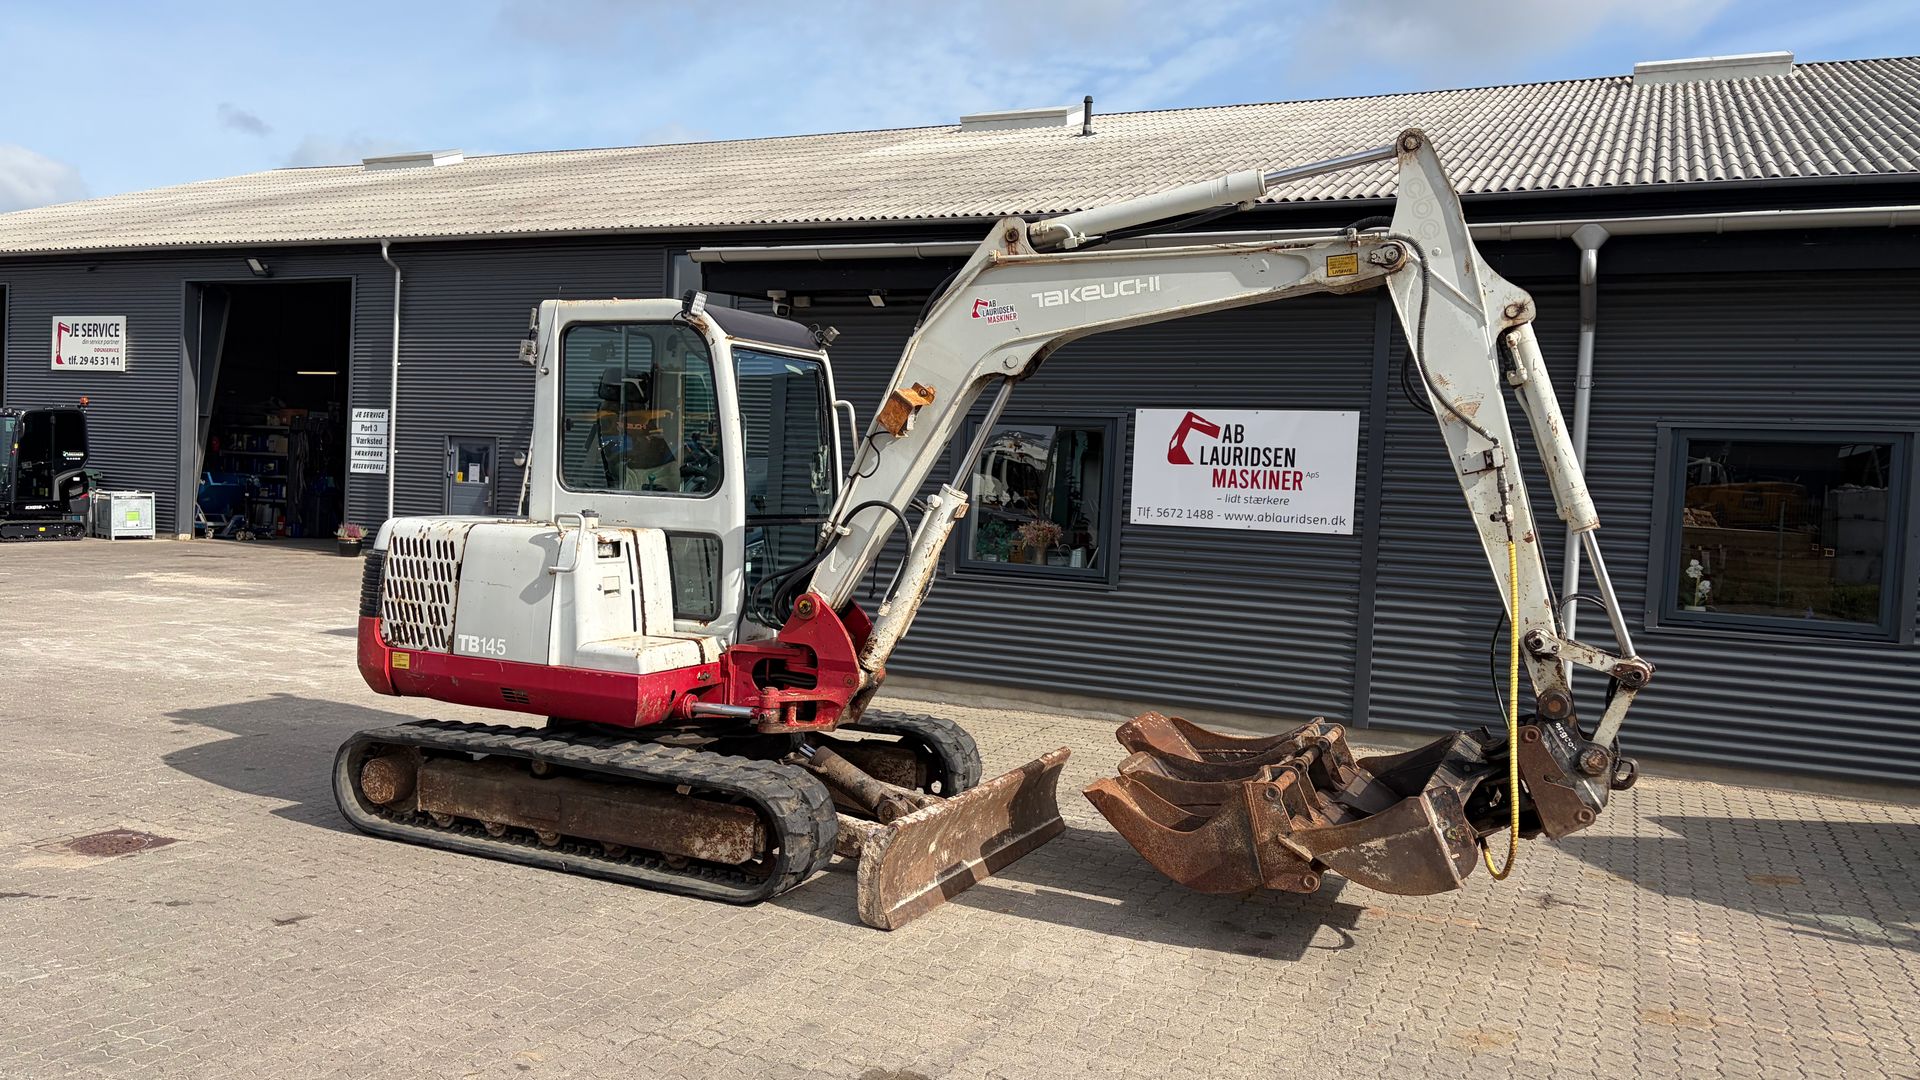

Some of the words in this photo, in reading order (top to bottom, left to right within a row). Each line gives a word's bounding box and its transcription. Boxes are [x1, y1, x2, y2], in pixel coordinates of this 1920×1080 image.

[1032, 274, 1161, 308] TAKEUCHI
[987, 313, 1017, 324] MASKINER
[69, 323, 79, 338] JE
[82, 323, 120, 338] SERVICE
[68, 355, 78, 365] tlf.
[80, 356, 89, 365] 29
[90, 356, 99, 365] 45
[100, 356, 109, 366] 31
[111, 356, 120, 366] 41
[363, 411, 385, 419] SERVICE
[361, 424, 373, 432] Port
[374, 424, 378, 432] 3
[1222, 424, 1244, 444] AB
[356, 437, 383, 445] Værksted
[1200, 446, 1296, 468] LAURIDSEN
[1212, 468, 1303, 491] MASKINER
[1306, 471, 1320, 479] ApS
[1225, 494, 1241, 504] lidt
[1244, 495, 1290, 506] stærkere
[1137, 507, 1153, 519] Tlf.
[1156, 508, 1183, 519] 5672
[1186, 508, 1214, 520] 1488
[1225, 512, 1347, 526] www.ablauridsen.dk
[457, 633, 507, 655] TB145
